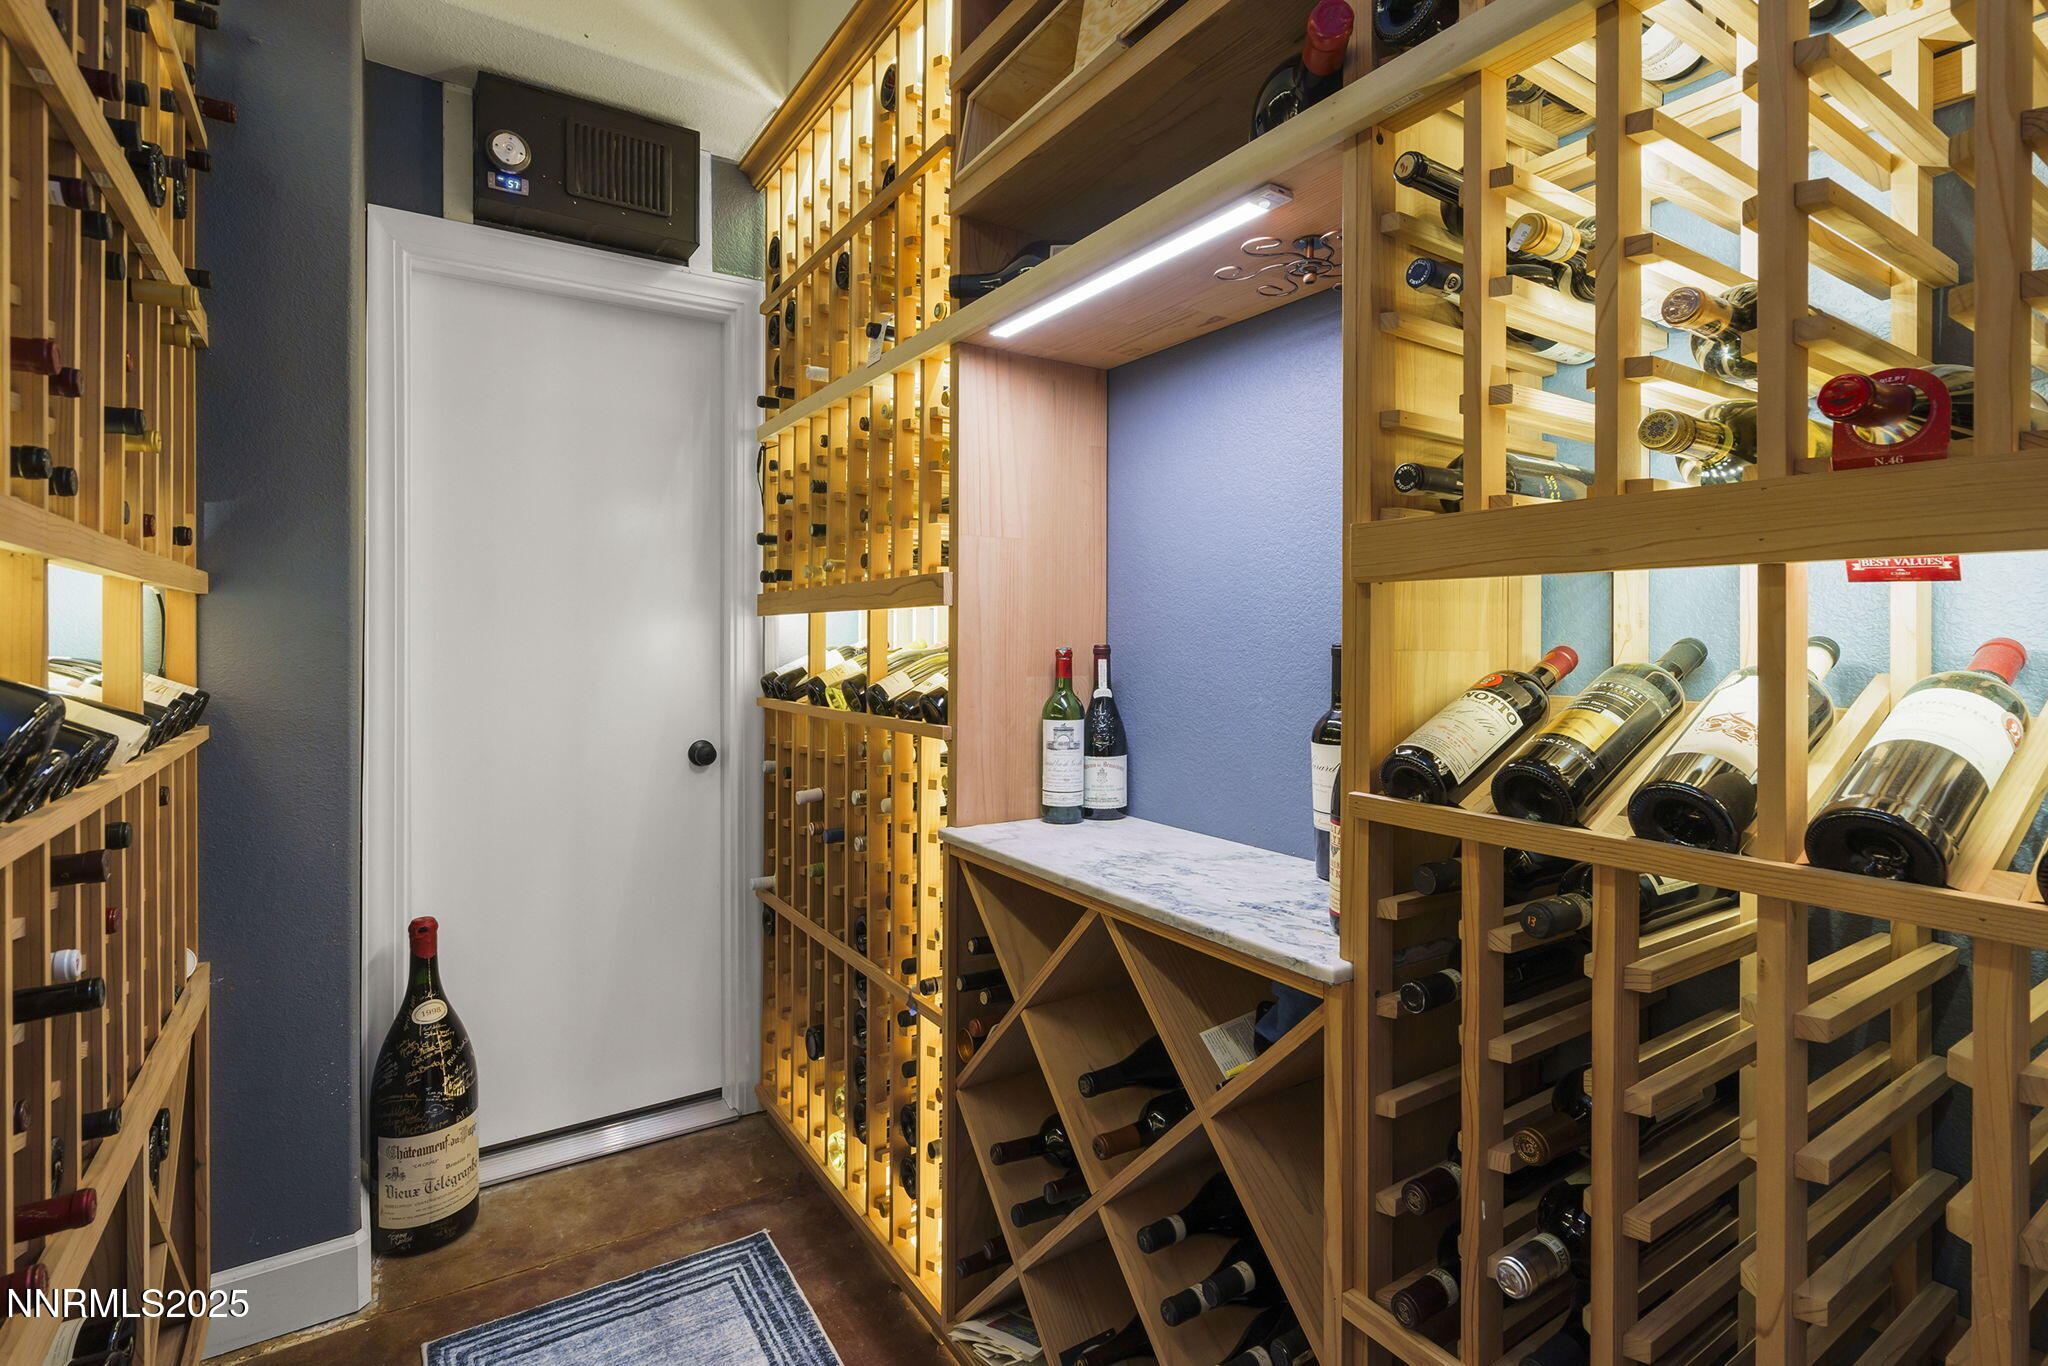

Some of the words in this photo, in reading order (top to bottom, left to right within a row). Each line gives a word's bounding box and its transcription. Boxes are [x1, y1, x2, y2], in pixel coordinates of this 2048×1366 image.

[507, 180, 519, 189] 57
[1873, 455, 1904, 466] N.46
[1861, 559, 1890, 567] BEST
[1893, 557, 1943, 566] VALUES
[421, 1006, 442, 1018] 1998
[384, 1184, 421, 1199] Vieux
